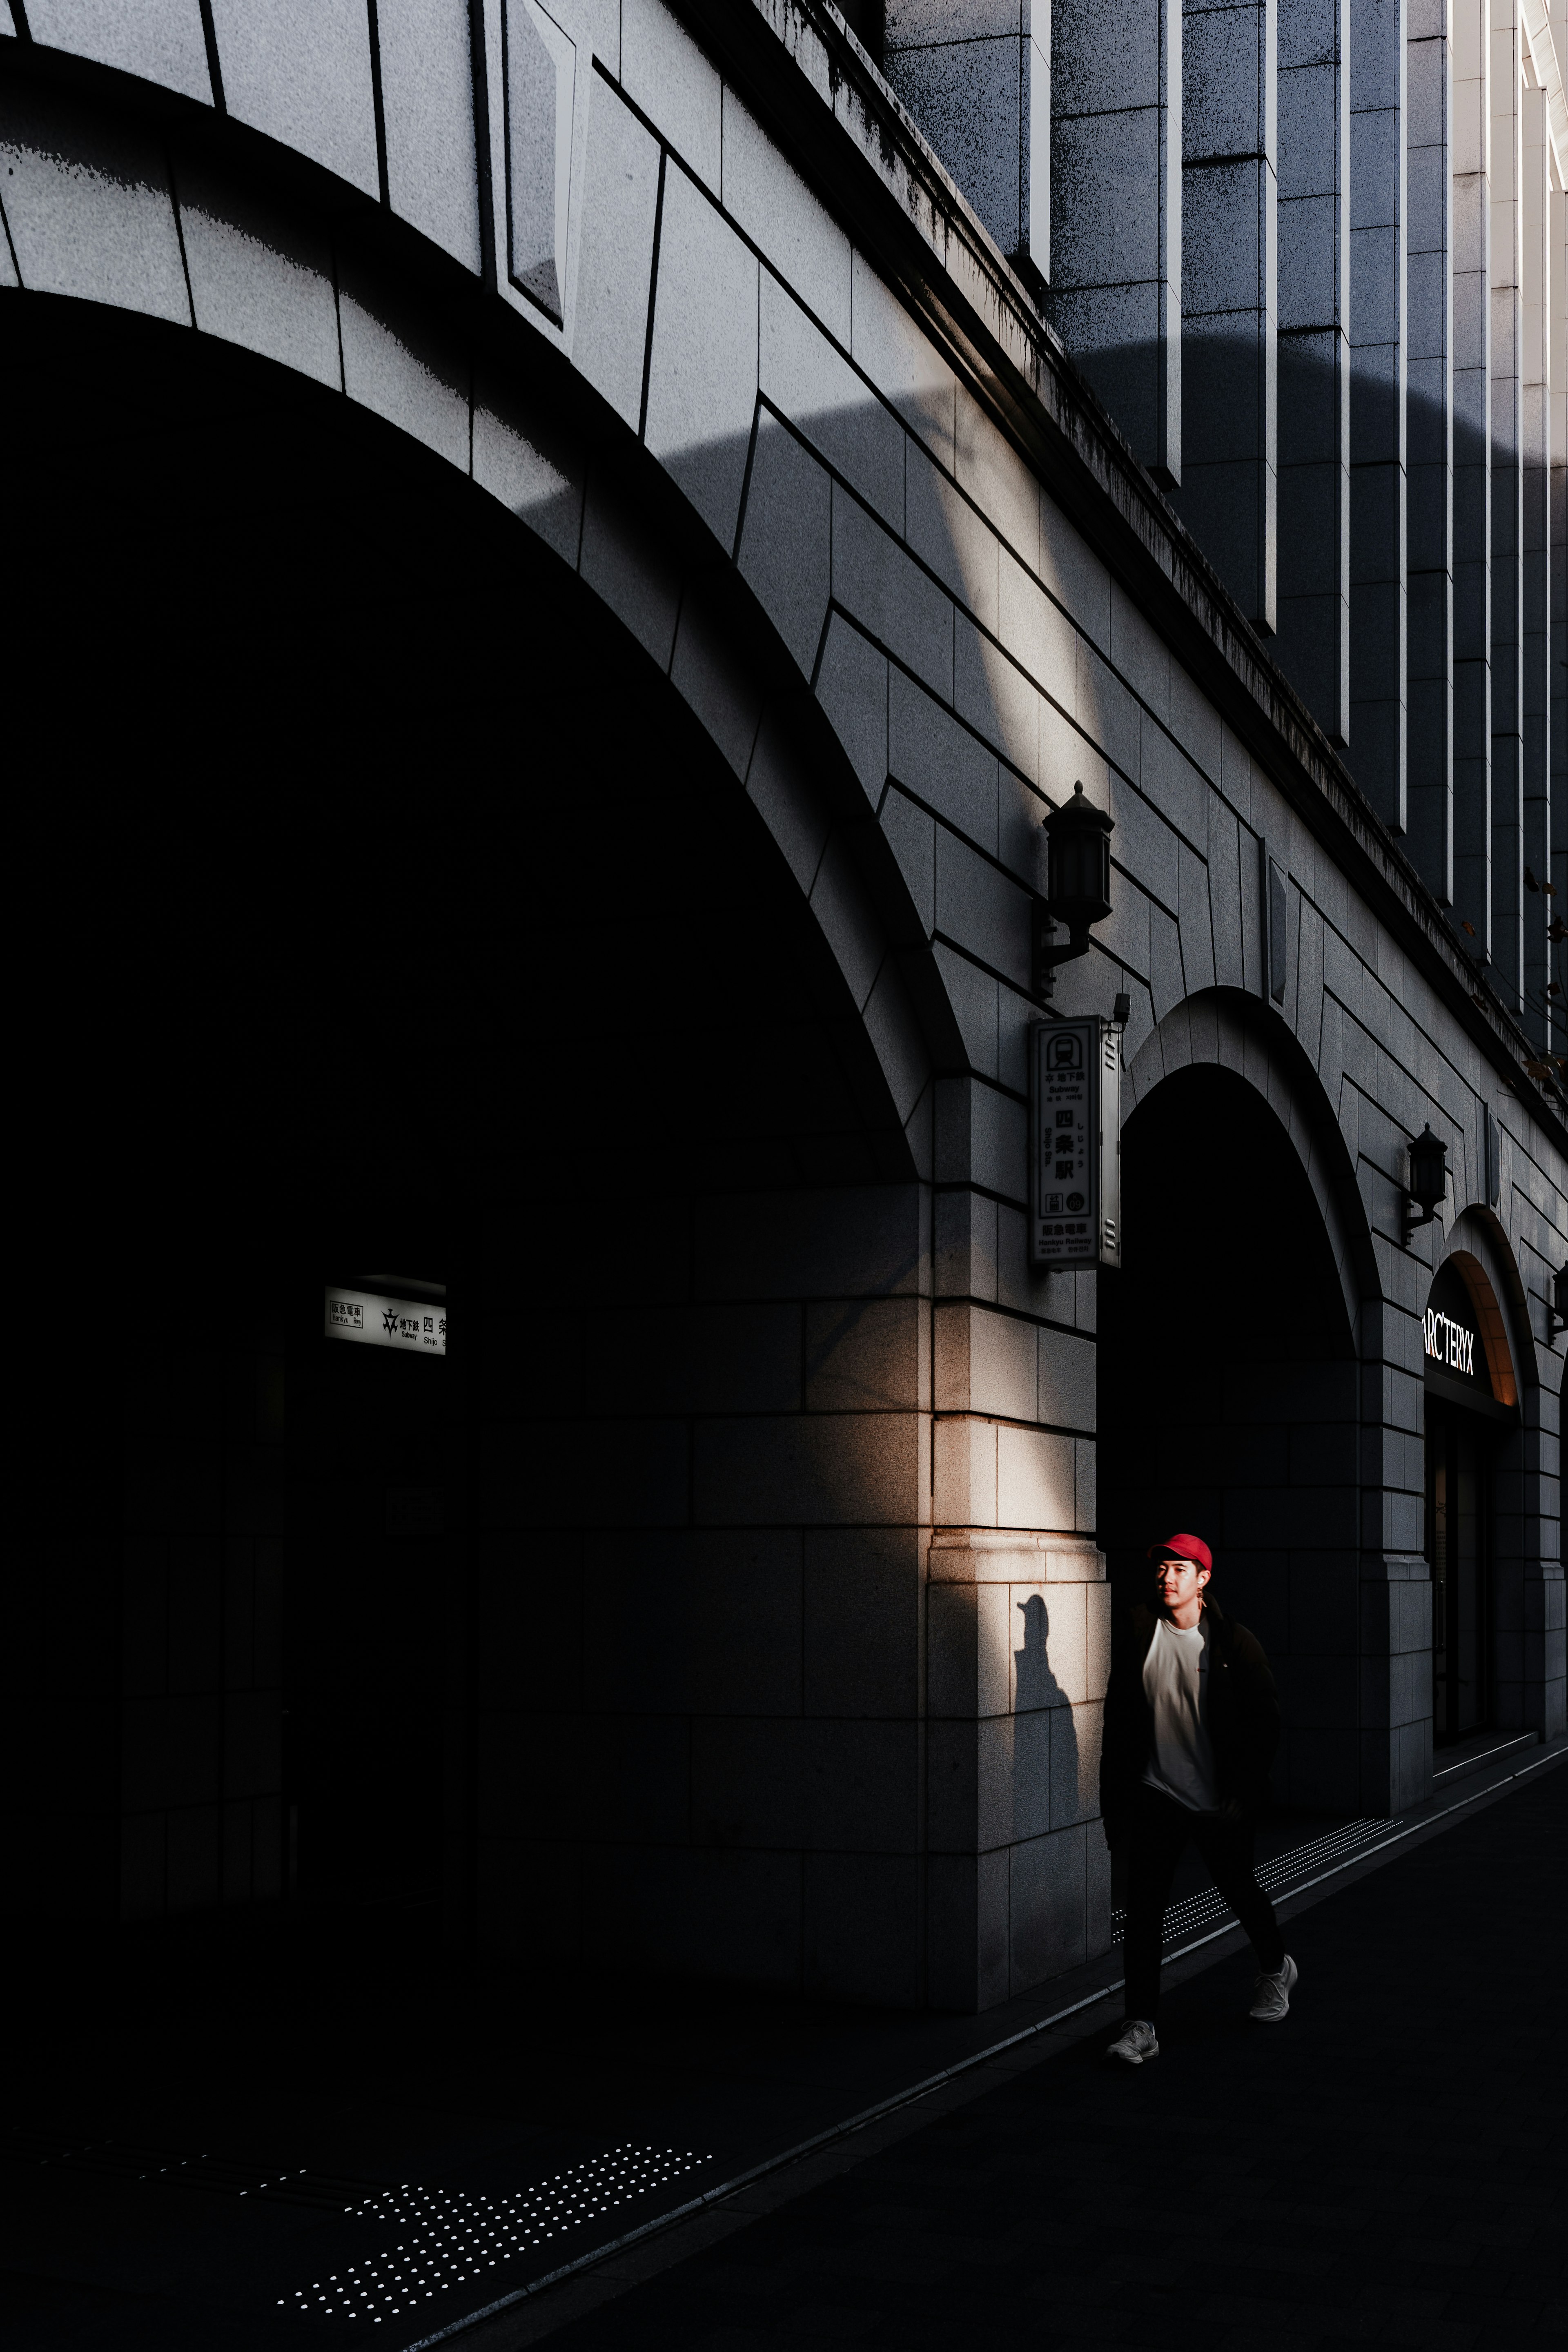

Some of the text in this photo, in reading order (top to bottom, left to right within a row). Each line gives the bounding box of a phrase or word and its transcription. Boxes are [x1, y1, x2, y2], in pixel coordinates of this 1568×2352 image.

[1057, 1071, 1085, 1082] 地下鉄
[1044, 1127, 1052, 1149] Shijo
[1055, 1109, 1074, 1180] 四条駅
[1069, 1200, 1081, 1209] 09
[1042, 1223, 1087, 1236] 阪急電車
[332, 1303, 361, 1317] 阪急電車
[332, 1314, 362, 1326] Hankyu Rwy
[399, 1318, 419, 1332] 地下鉄
[402, 1331, 417, 1341] Subway
[424, 1336, 438, 1347] Shijo
